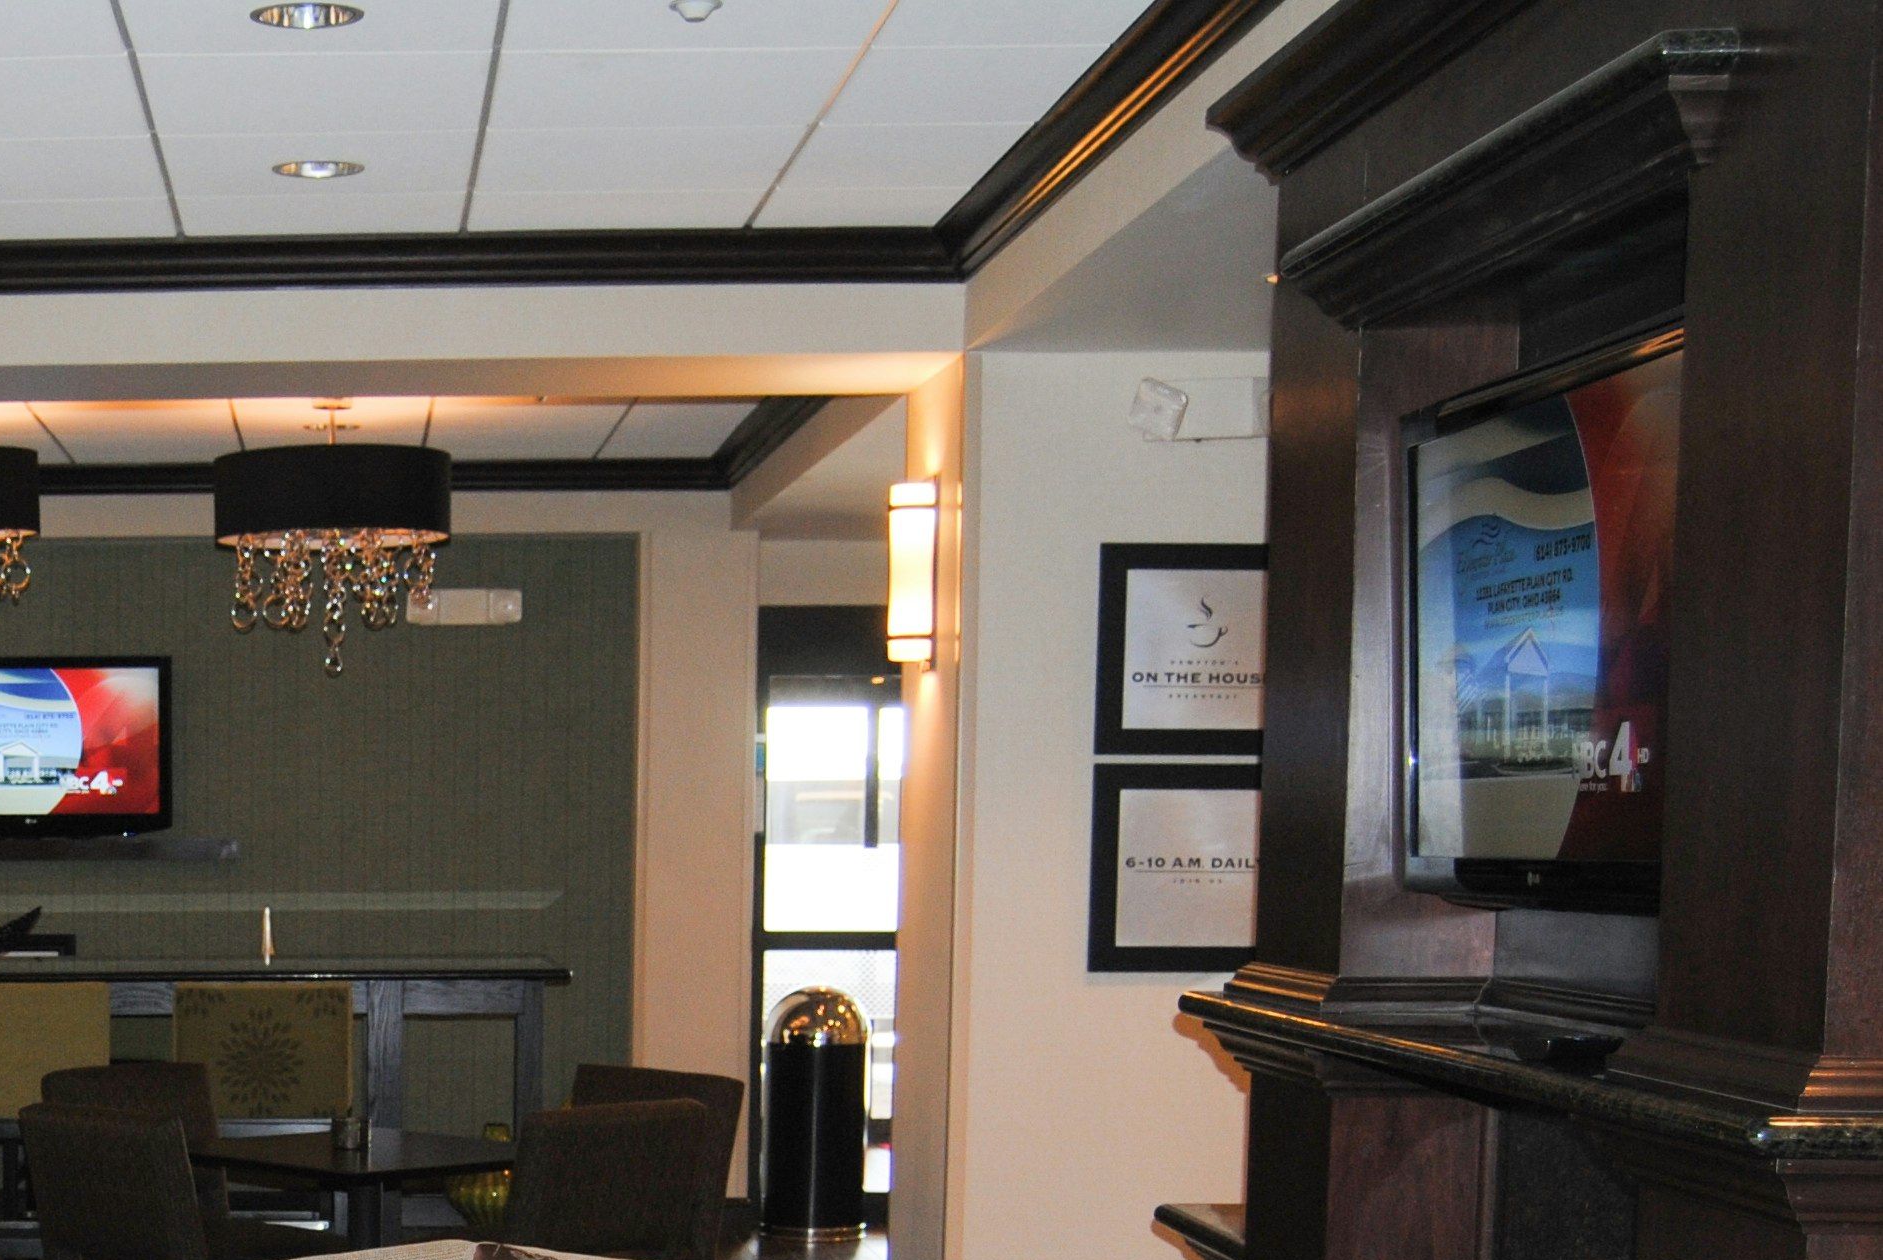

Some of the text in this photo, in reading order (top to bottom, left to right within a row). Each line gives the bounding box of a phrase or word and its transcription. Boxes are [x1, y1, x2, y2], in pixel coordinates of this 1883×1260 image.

[1131, 671, 1267, 685] ON THE HOUS
[1572, 739, 1607, 779] NBC
[1609, 720, 1633, 792] 4
[90, 770, 110, 795] 4
[1125, 857, 1166, 868] 6-10
[1211, 857, 1260, 869] DAIL
